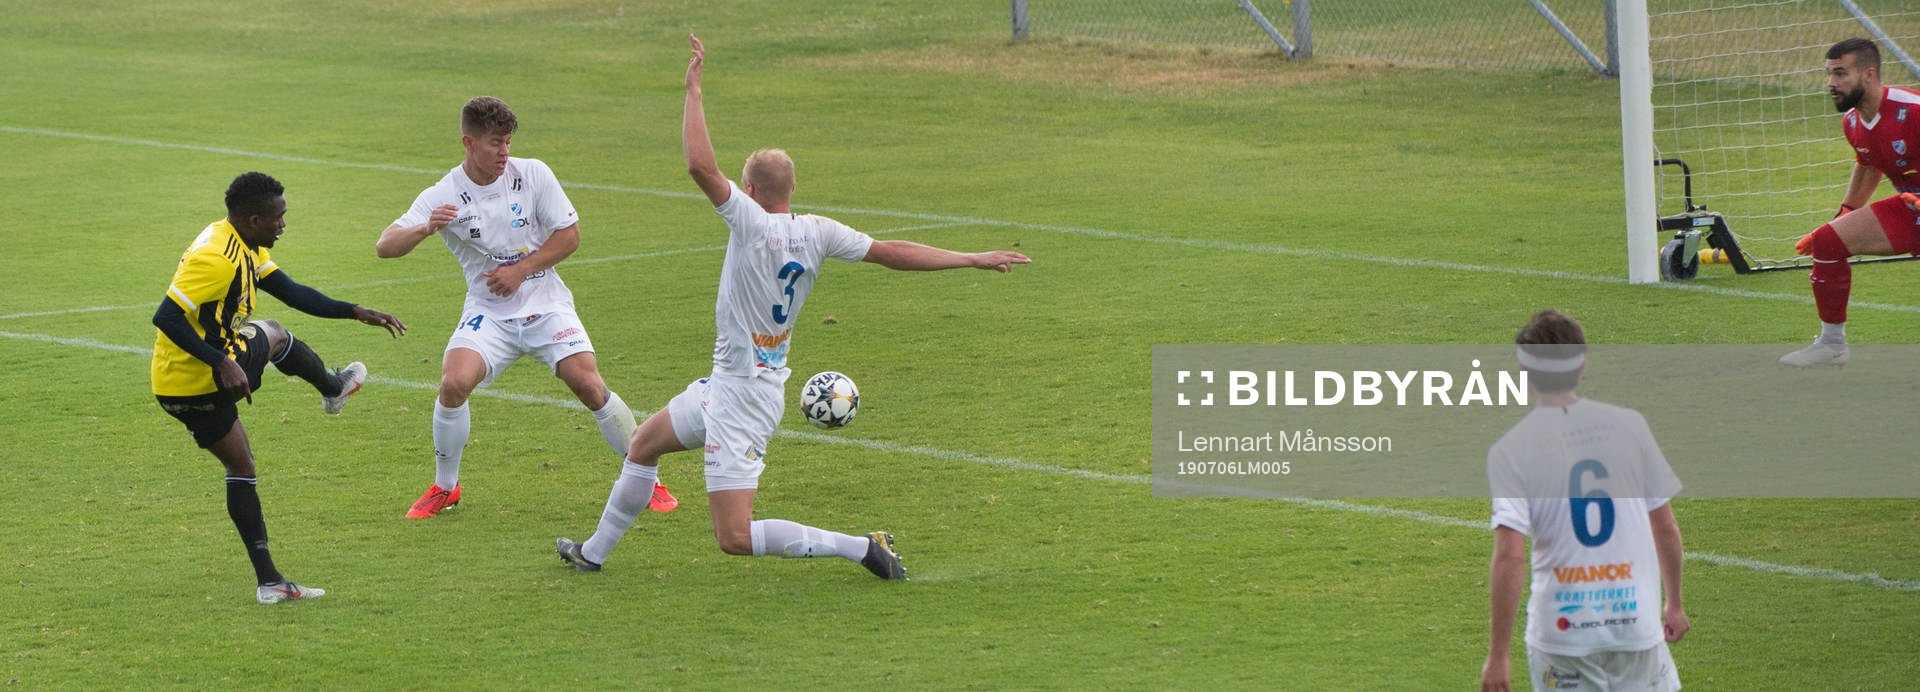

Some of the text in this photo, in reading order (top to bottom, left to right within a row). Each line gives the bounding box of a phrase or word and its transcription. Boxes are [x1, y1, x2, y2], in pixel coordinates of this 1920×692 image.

[772, 261, 805, 324] 3
[1568, 458, 1616, 548] 6
[1553, 563, 1633, 584] VIANOR
